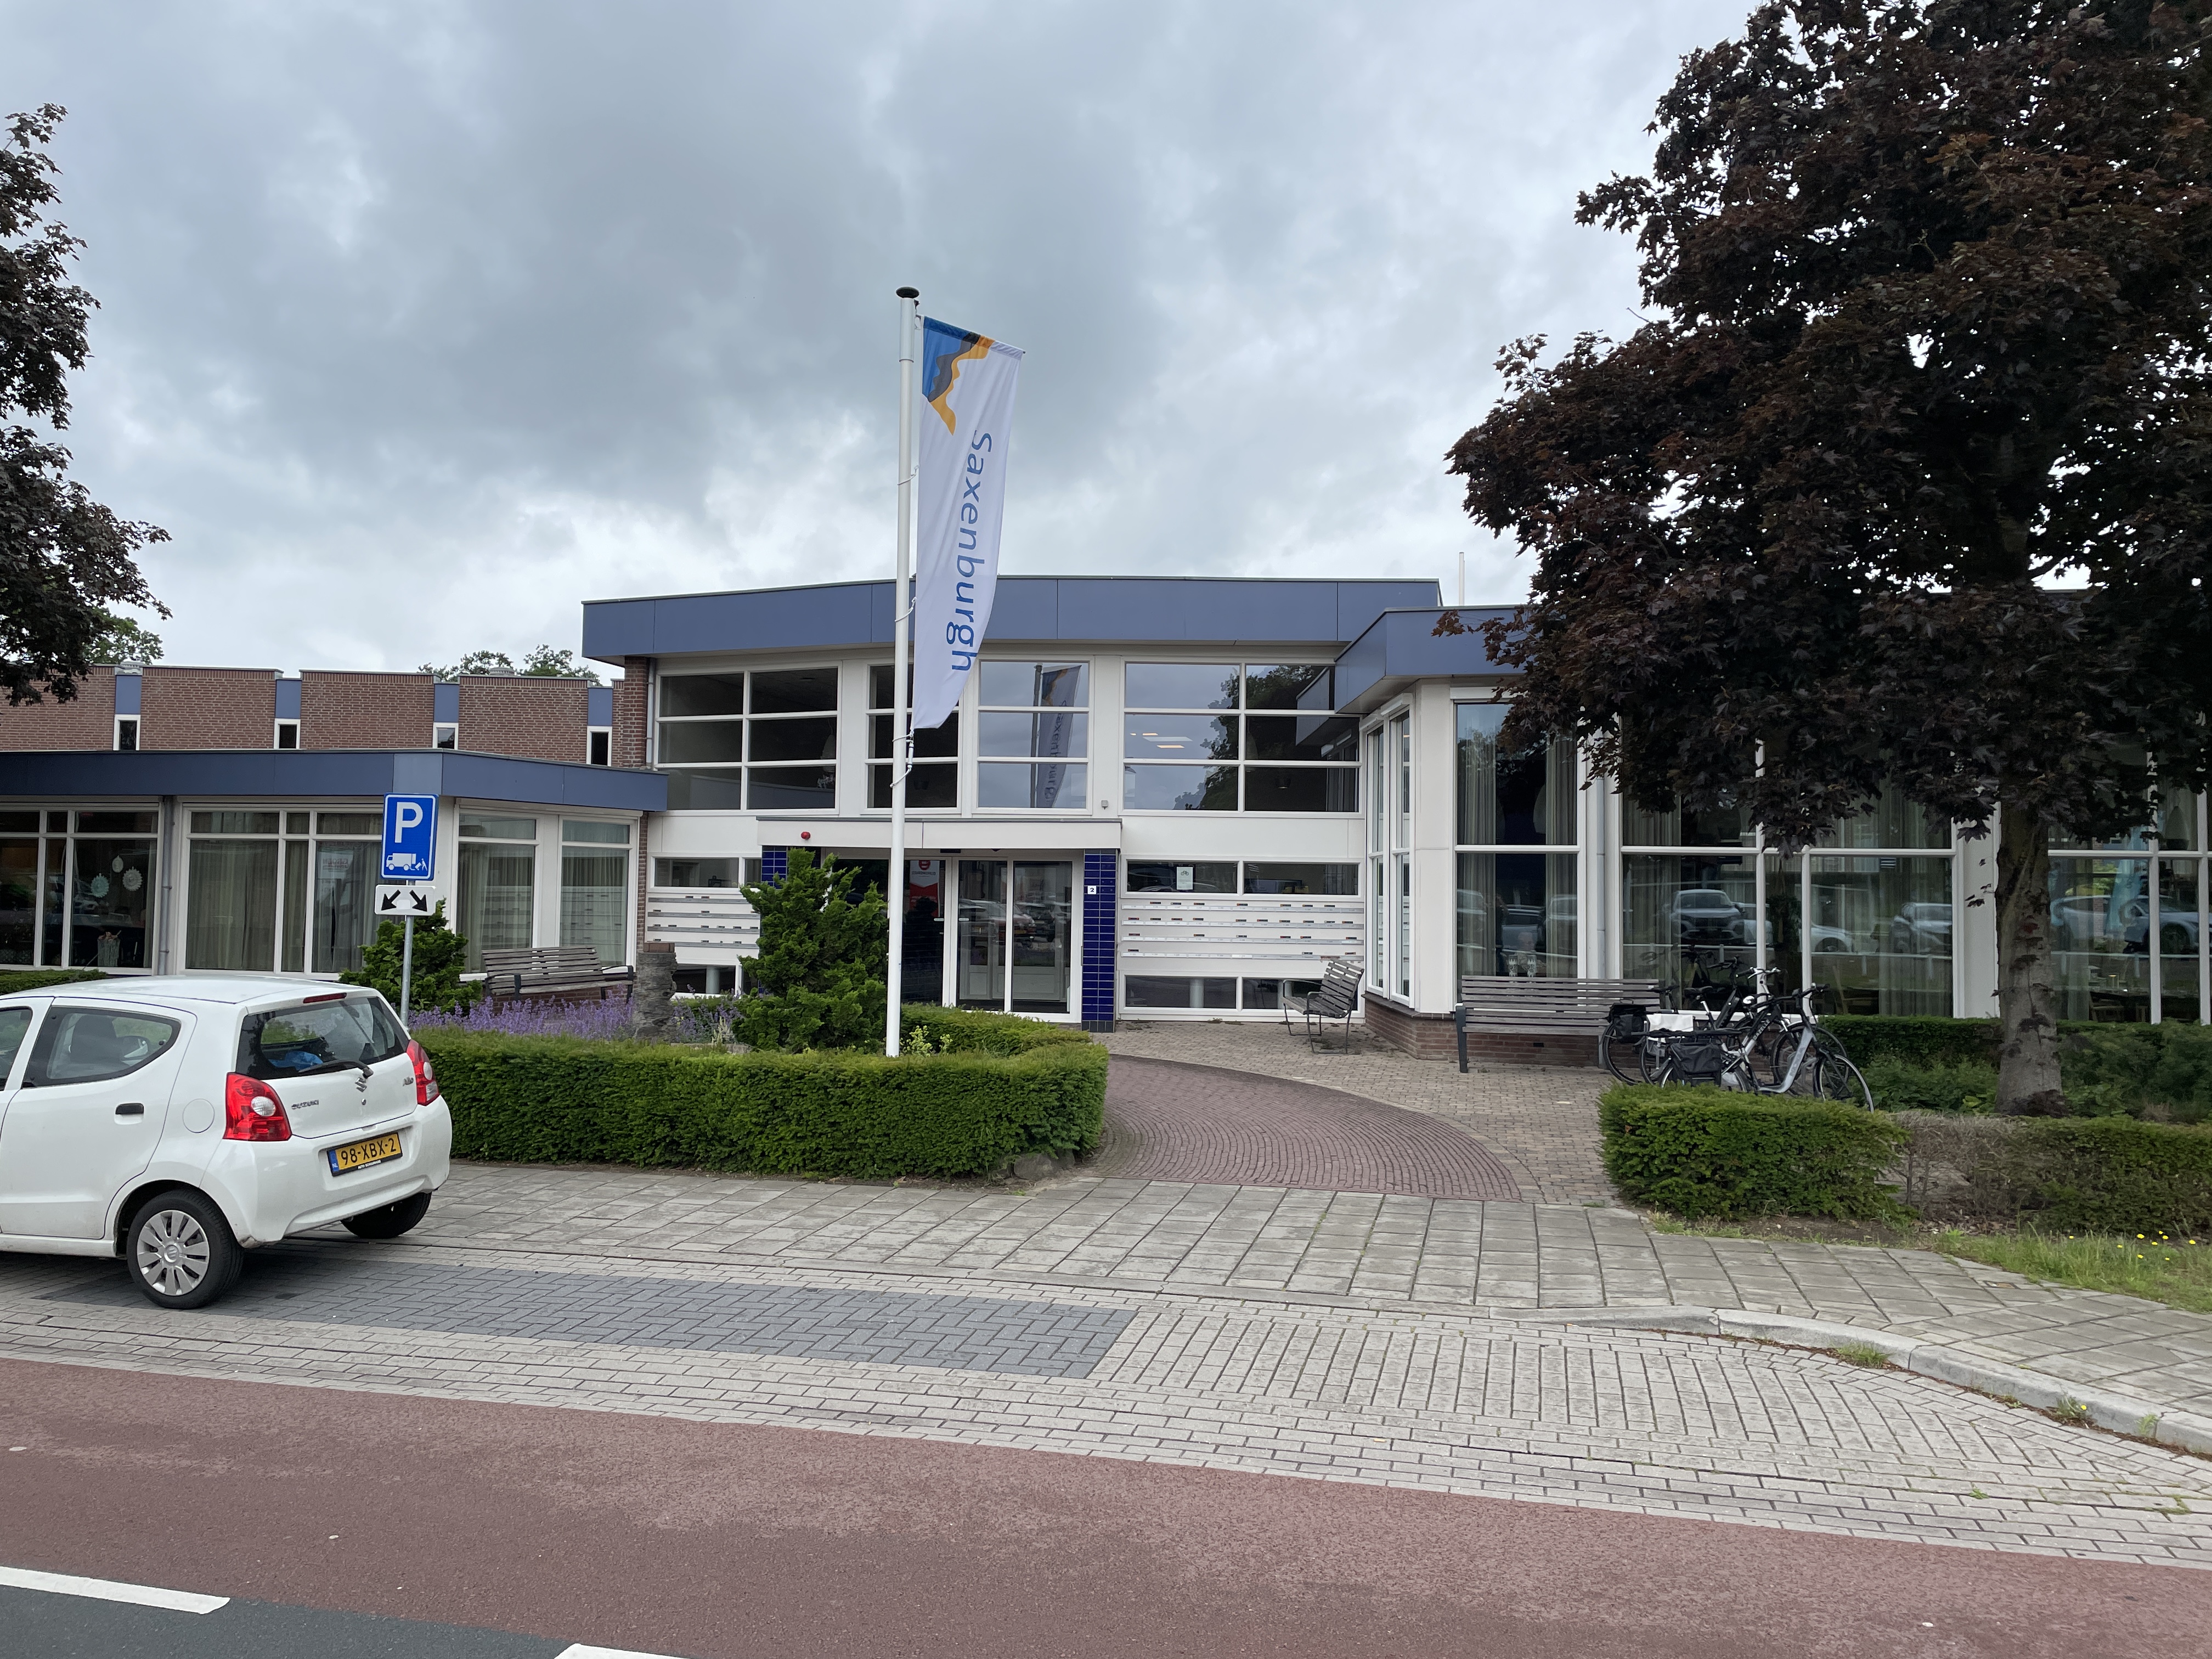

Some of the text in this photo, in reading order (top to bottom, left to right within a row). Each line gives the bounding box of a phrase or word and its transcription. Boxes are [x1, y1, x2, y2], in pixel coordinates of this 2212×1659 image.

[946, 430, 992, 671] Saxenburgh
[394, 802, 424, 843] P
[1753, 1019, 1770, 1040] GAZELLE
[291, 1099, 319, 1110] SUZUKI
[341, 1137, 397, 1166] 98-XBX-2
